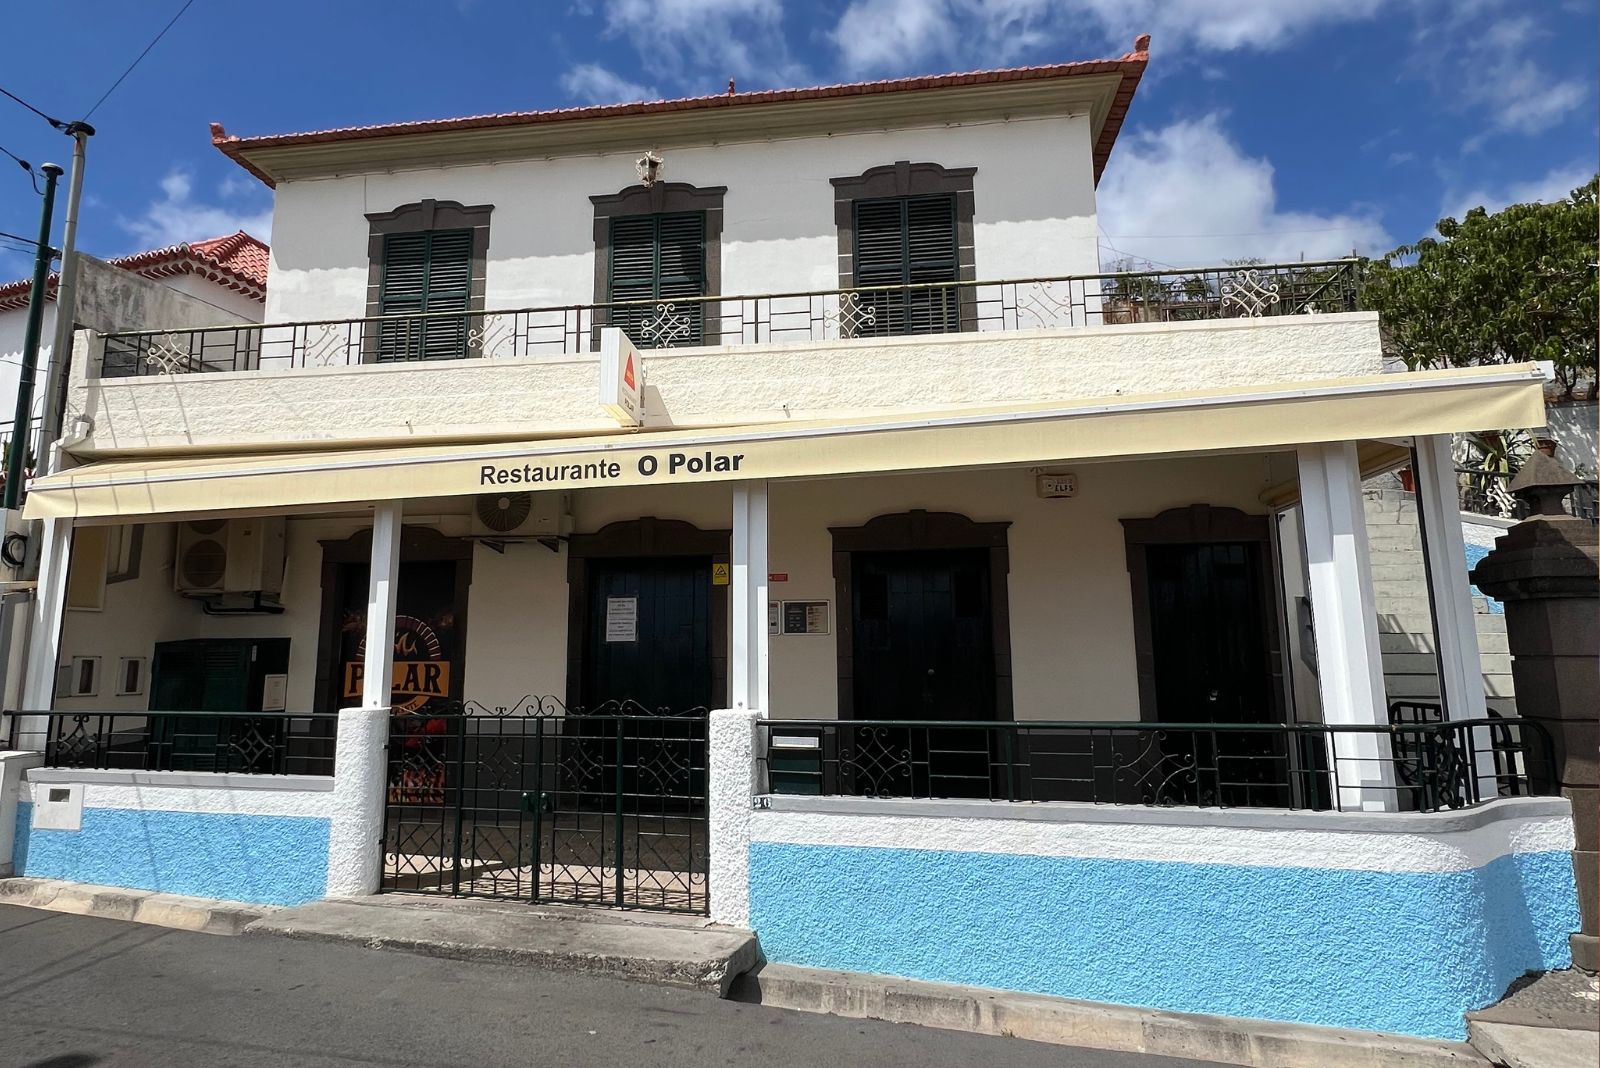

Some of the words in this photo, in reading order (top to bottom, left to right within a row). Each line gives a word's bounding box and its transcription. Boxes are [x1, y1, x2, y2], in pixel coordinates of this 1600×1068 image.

[480, 459, 621, 485] Restaurante
[637, 455, 658, 476] O
[669, 452, 744, 475] Polar
[349, 663, 442, 694] PAR
